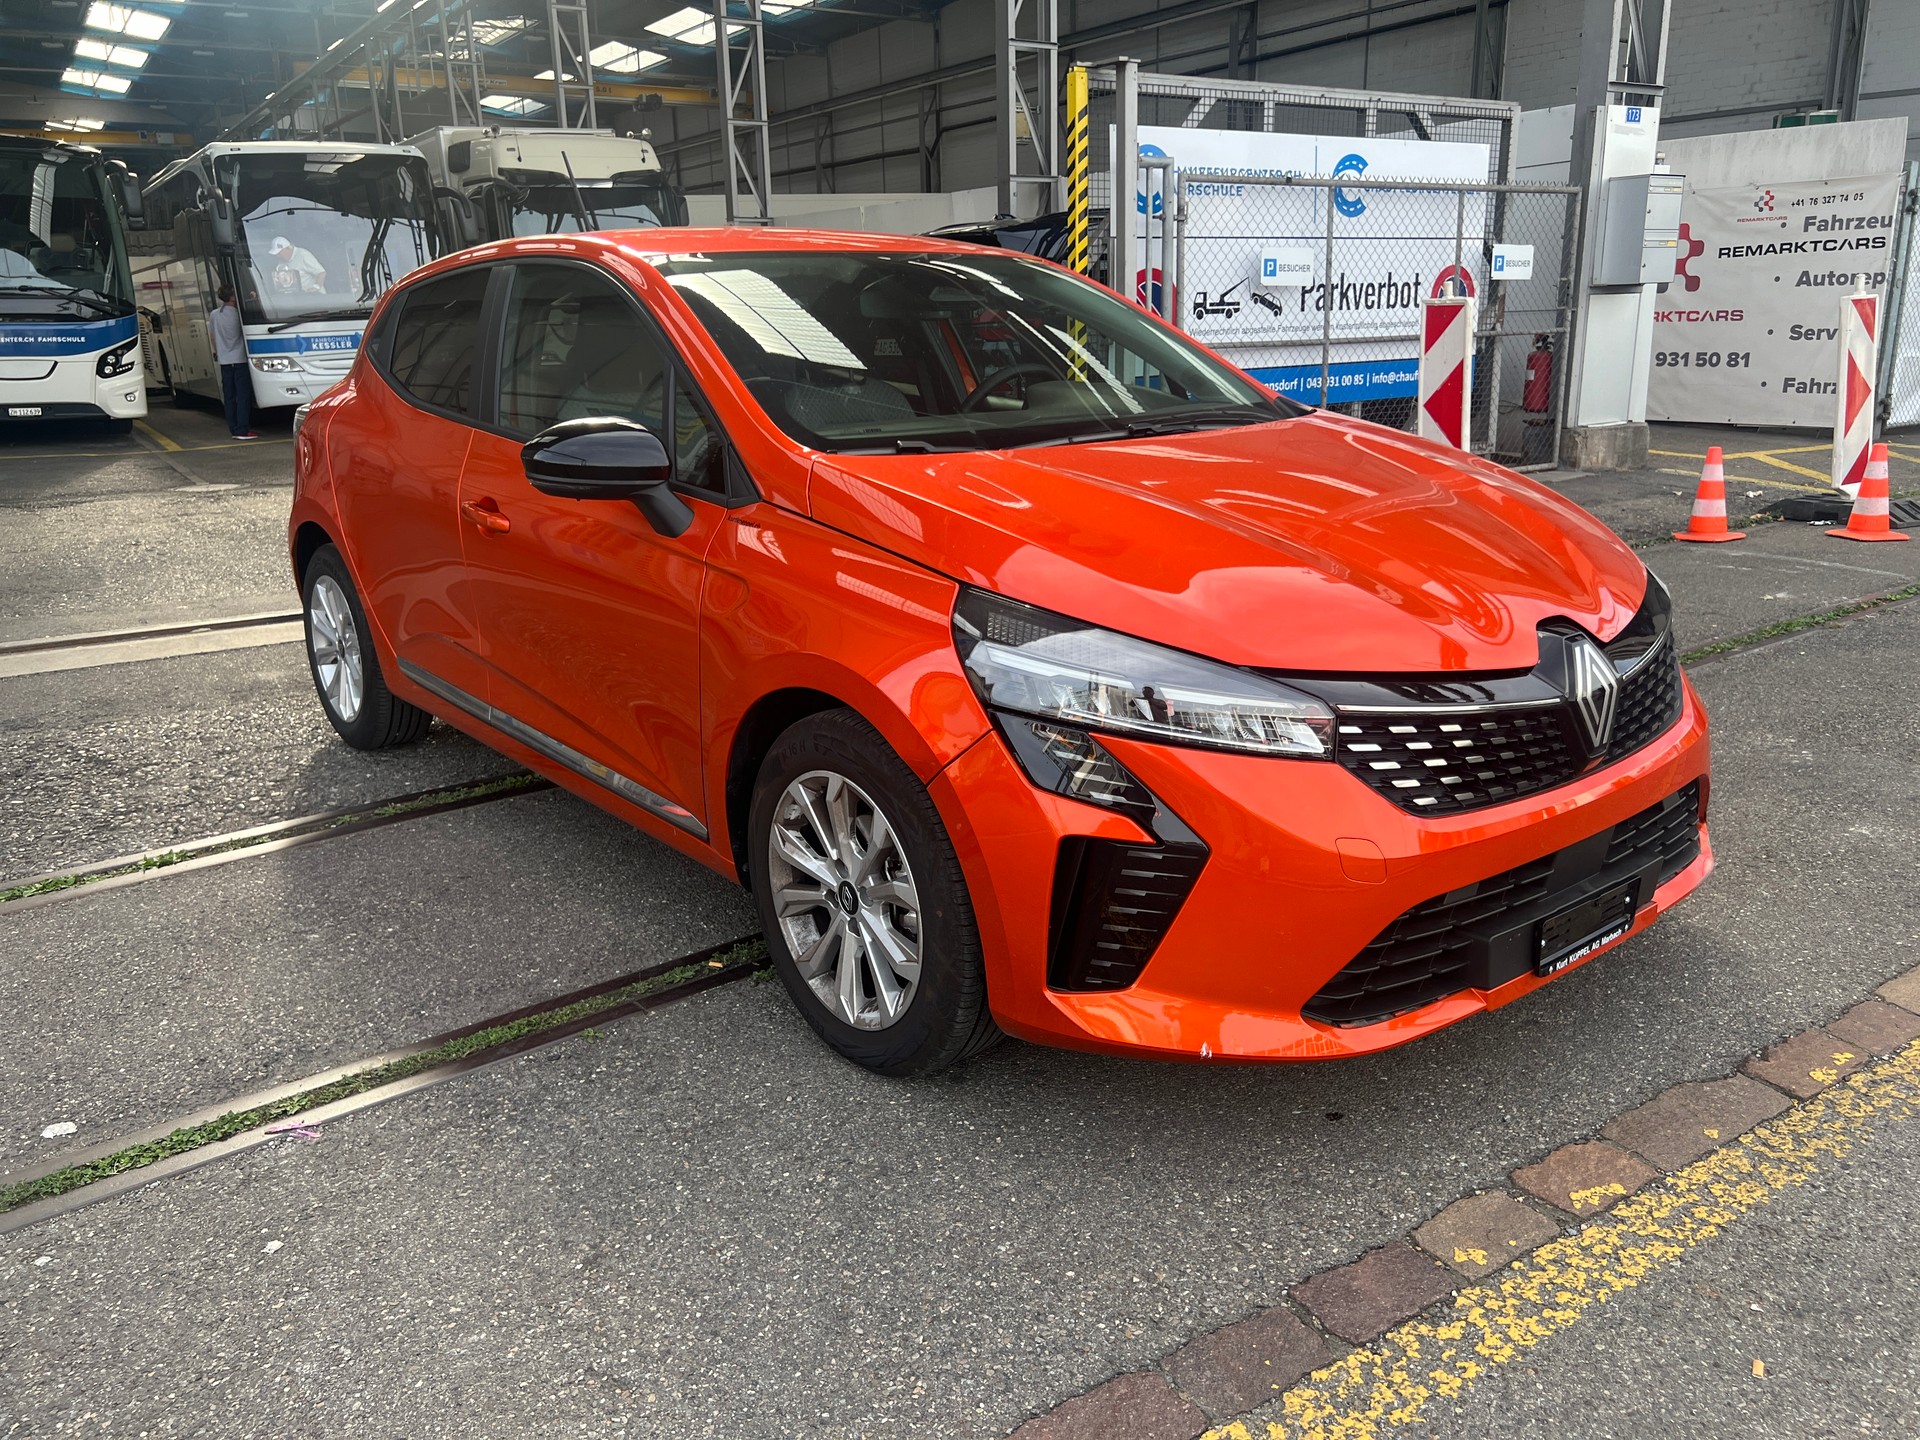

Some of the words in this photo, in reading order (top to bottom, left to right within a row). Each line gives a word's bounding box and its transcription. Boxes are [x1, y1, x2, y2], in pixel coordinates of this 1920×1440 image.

[1628, 109, 1640, 121] 173
[1791, 199, 1805, 208] +41
[1809, 197, 1819, 206] 76
[1822, 195, 1836, 205] 327
[1840, 194, 1849, 203] 74
[1853, 192, 1864, 201] 05
[1737, 215, 1788, 223] REMARKTCARS
[1803, 214, 1893, 233] Fahrzeu
[1717, 236, 1886, 260] REMARKTCARS
[1279, 264, 1311, 272] BESUCHER
[1505, 259, 1531, 268] BESUCHER
[1300, 271, 1421, 312] Parkverbot
[1788, 324, 1839, 341] Serv
[312, 341, 353, 350] KESSLER
[1655, 352, 1690, 368] 931
[1695, 352, 1721, 368] 50
[1726, 352, 1750, 368] 81
[1306, 376, 1322, 389] 043
[1341, 375, 1352, 387] 00
[1353, 374, 1364, 386] 85
[1555, 958, 1568, 971] Kurt
[1591, 940, 1600, 951] AG
